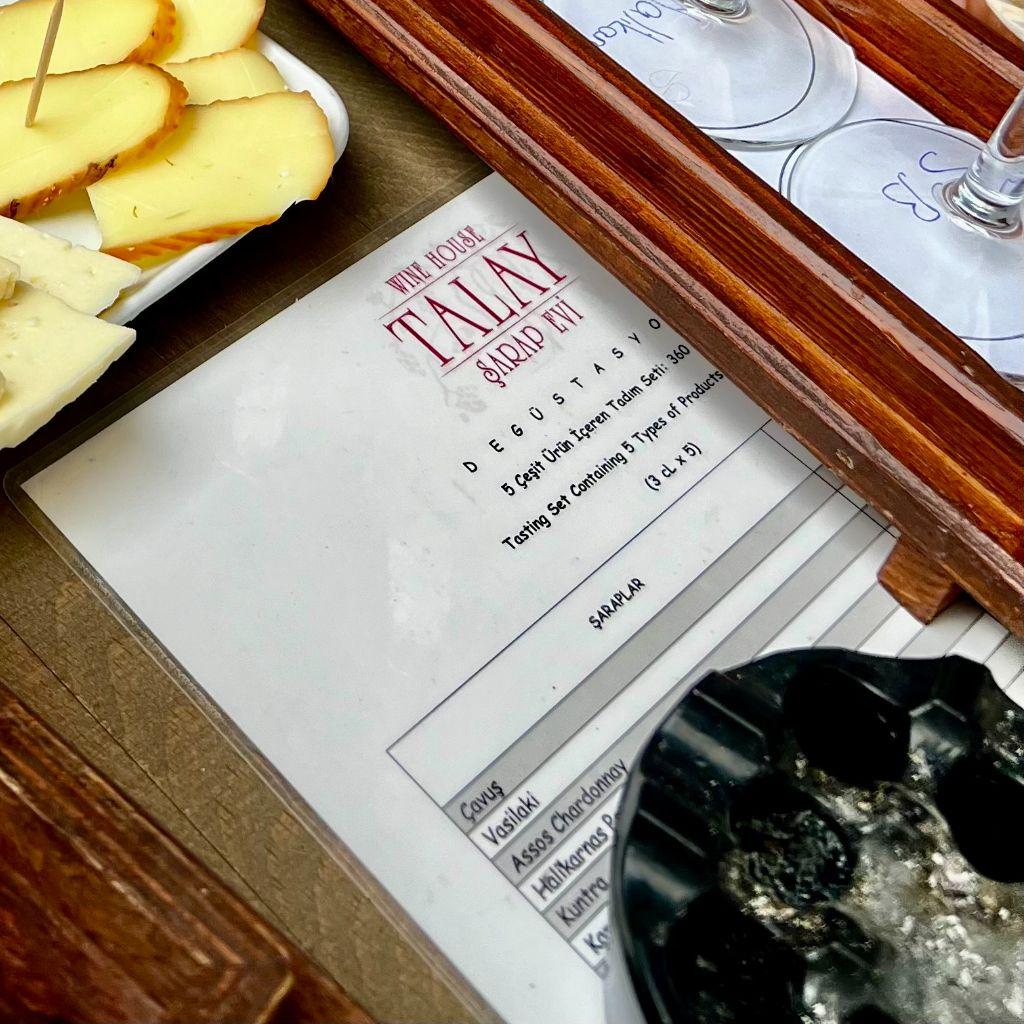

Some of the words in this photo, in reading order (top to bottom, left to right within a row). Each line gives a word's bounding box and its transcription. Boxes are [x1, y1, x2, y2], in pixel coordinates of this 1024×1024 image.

[385, 261, 432, 295] WINE
[424, 225, 486, 270] HOUSE
[382, 230, 567, 367] TALAY
[476, 326, 544, 388] ŞARAP
[541, 295, 584, 334] EVİ
[462, 317, 662, 474] DEGÜSTASYO
[500, 483, 516, 497] 5
[514, 460, 546, 489] Çeşit
[542, 438, 574, 464] Ürün
[569, 411, 611, 443] İçeren
[606, 385, 644, 412] Tadım
[640, 363, 669, 387] Seti:
[666, 344, 690, 365] 360
[501, 514, 551, 551] Tasting
[547, 495, 571, 516] Set
[569, 452, 627, 498] Containing
[621, 440, 635, 454] 5
[631, 417, 668, 444] Types
[667, 403, 681, 419] of
[677, 369, 724, 408] Products
[644, 474, 661, 492] (3
[675, 454, 687, 466] x
[682, 442, 702, 457] 5)
[588, 576, 646, 630] ŞARAPLAR
[459, 780, 505, 825] Çavuş
[480, 790, 542, 846] Vasilaki
[511, 827, 555, 874] Assos
[550, 758, 629, 833] Chardonnay
[531, 827, 609, 902] Halikarnas
[557, 877, 609, 927] Kuntra
